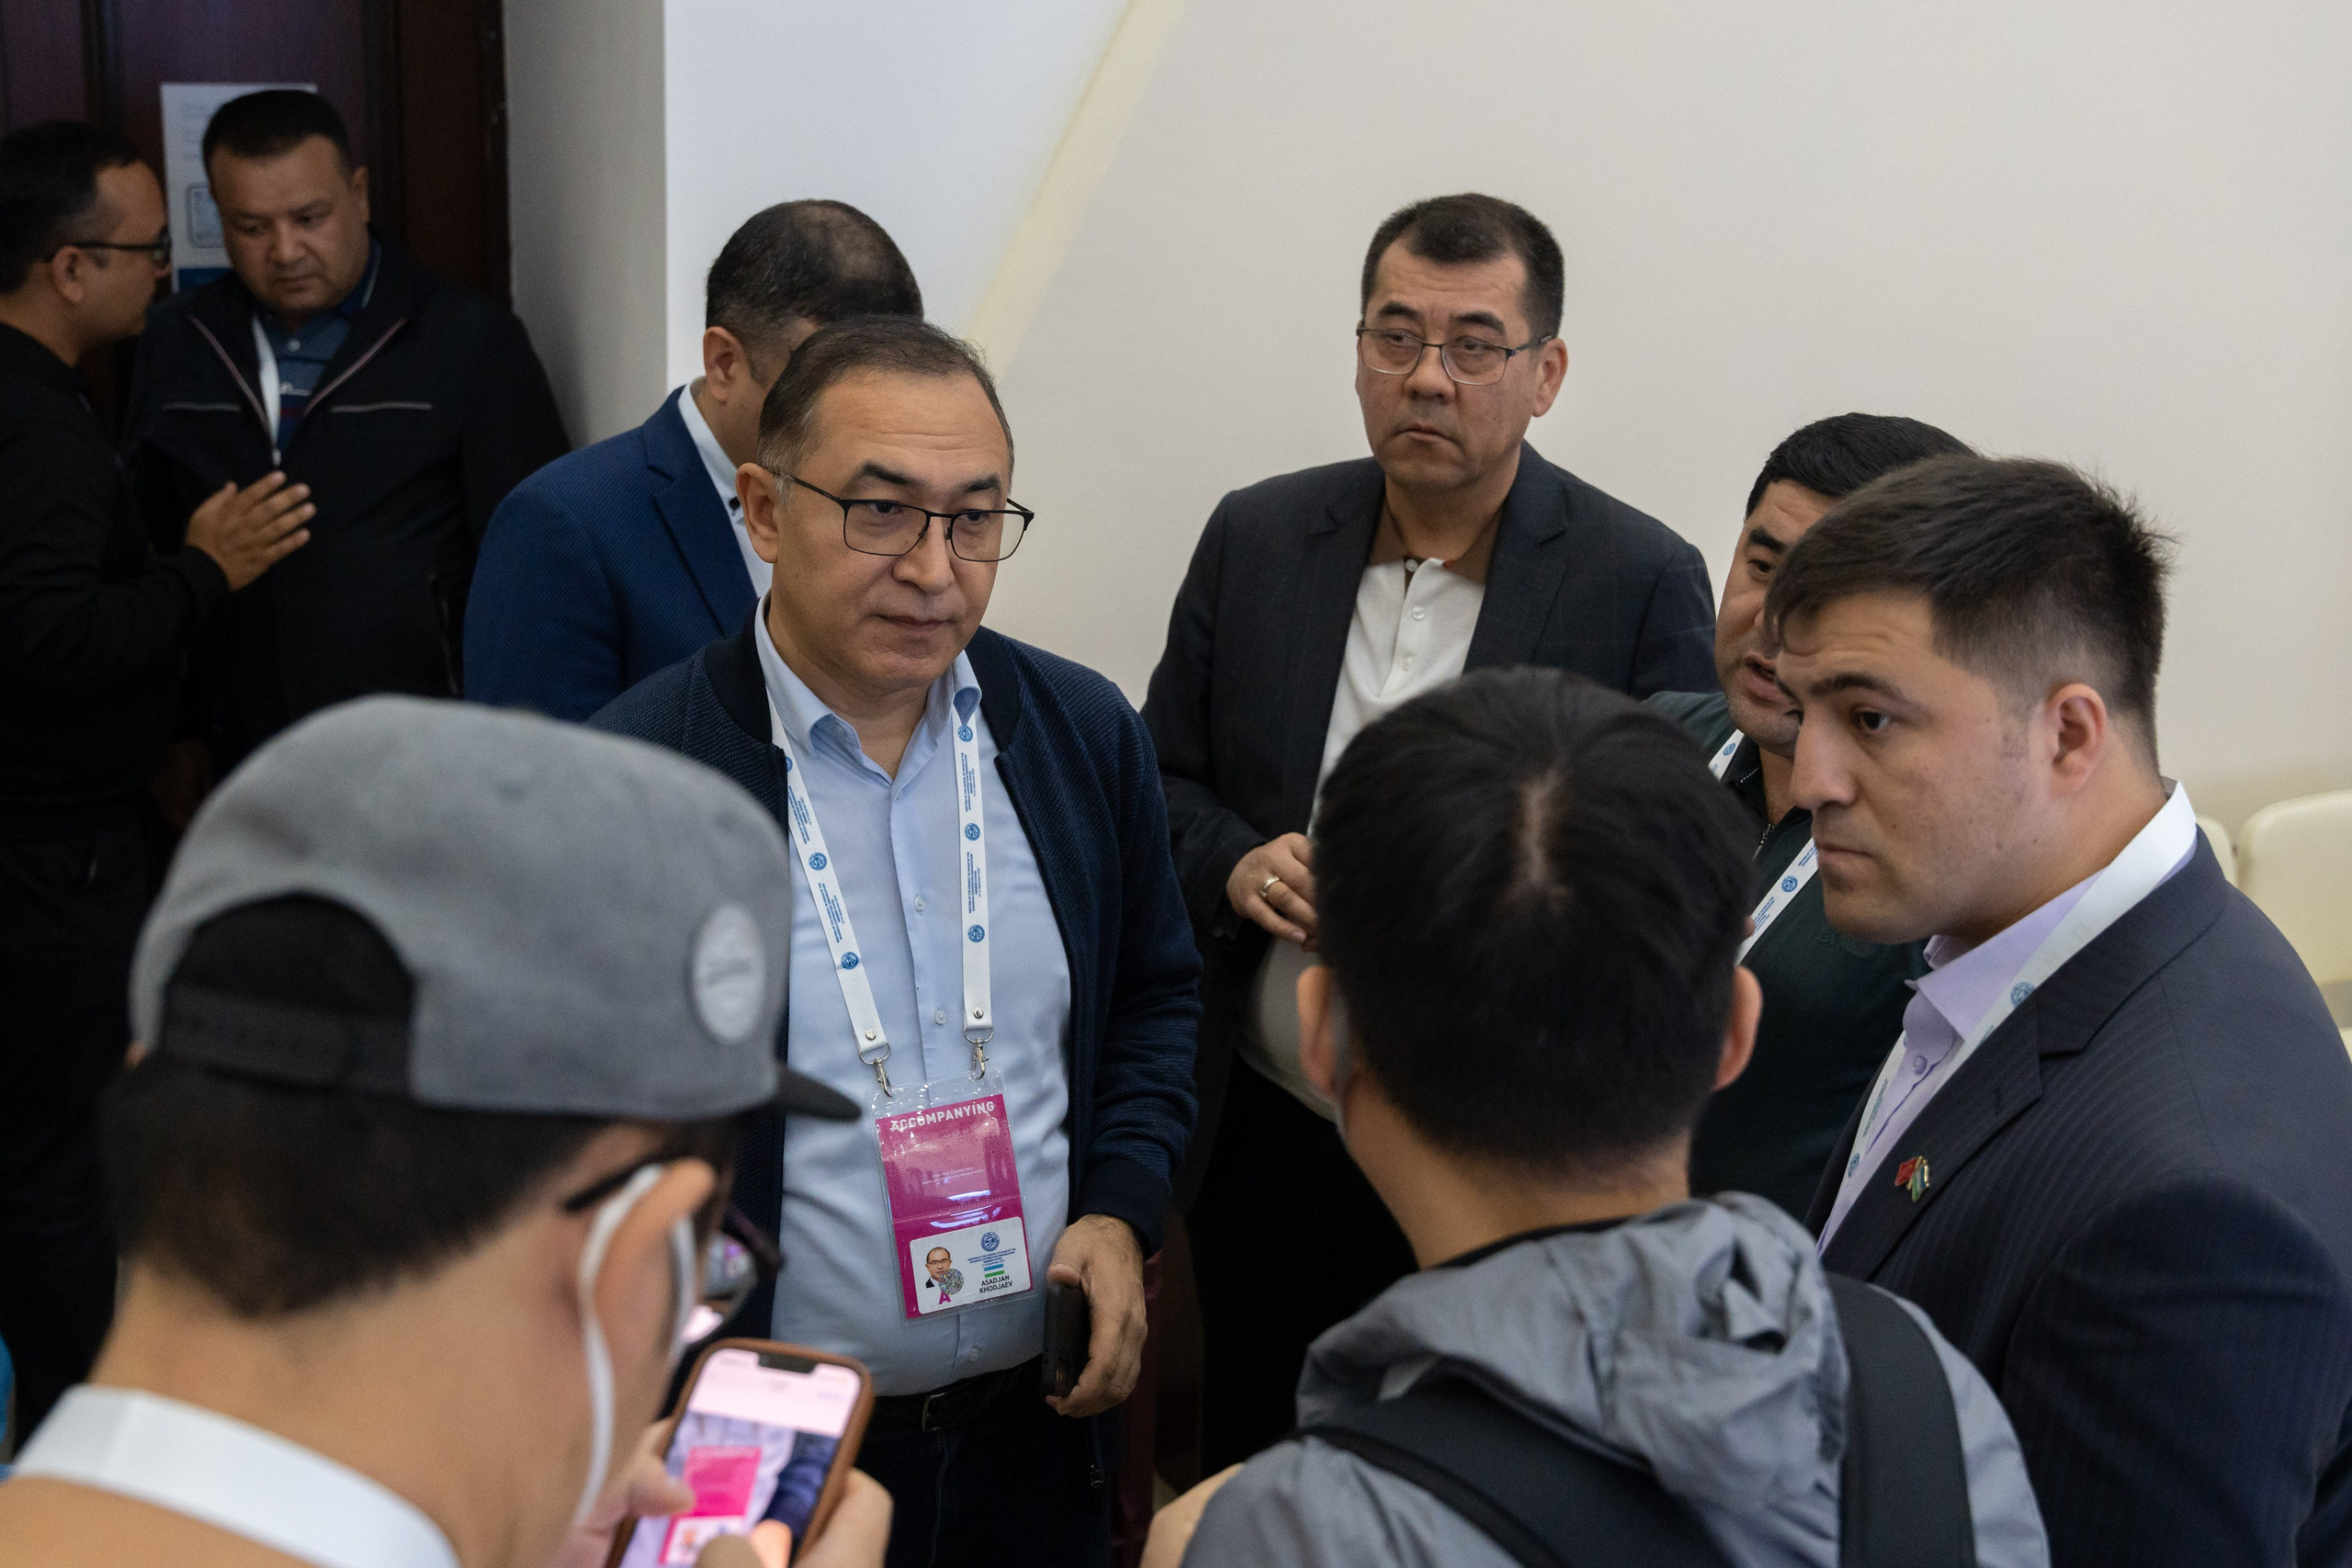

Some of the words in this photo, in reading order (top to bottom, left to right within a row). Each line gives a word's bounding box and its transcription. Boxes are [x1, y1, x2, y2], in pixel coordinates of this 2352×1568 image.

[891, 1100, 995, 1132] ACCOMPANYING
[979, 1280, 1013, 1294] KHODJAEV
[981, 1275, 1010, 1287] ASADJAN
